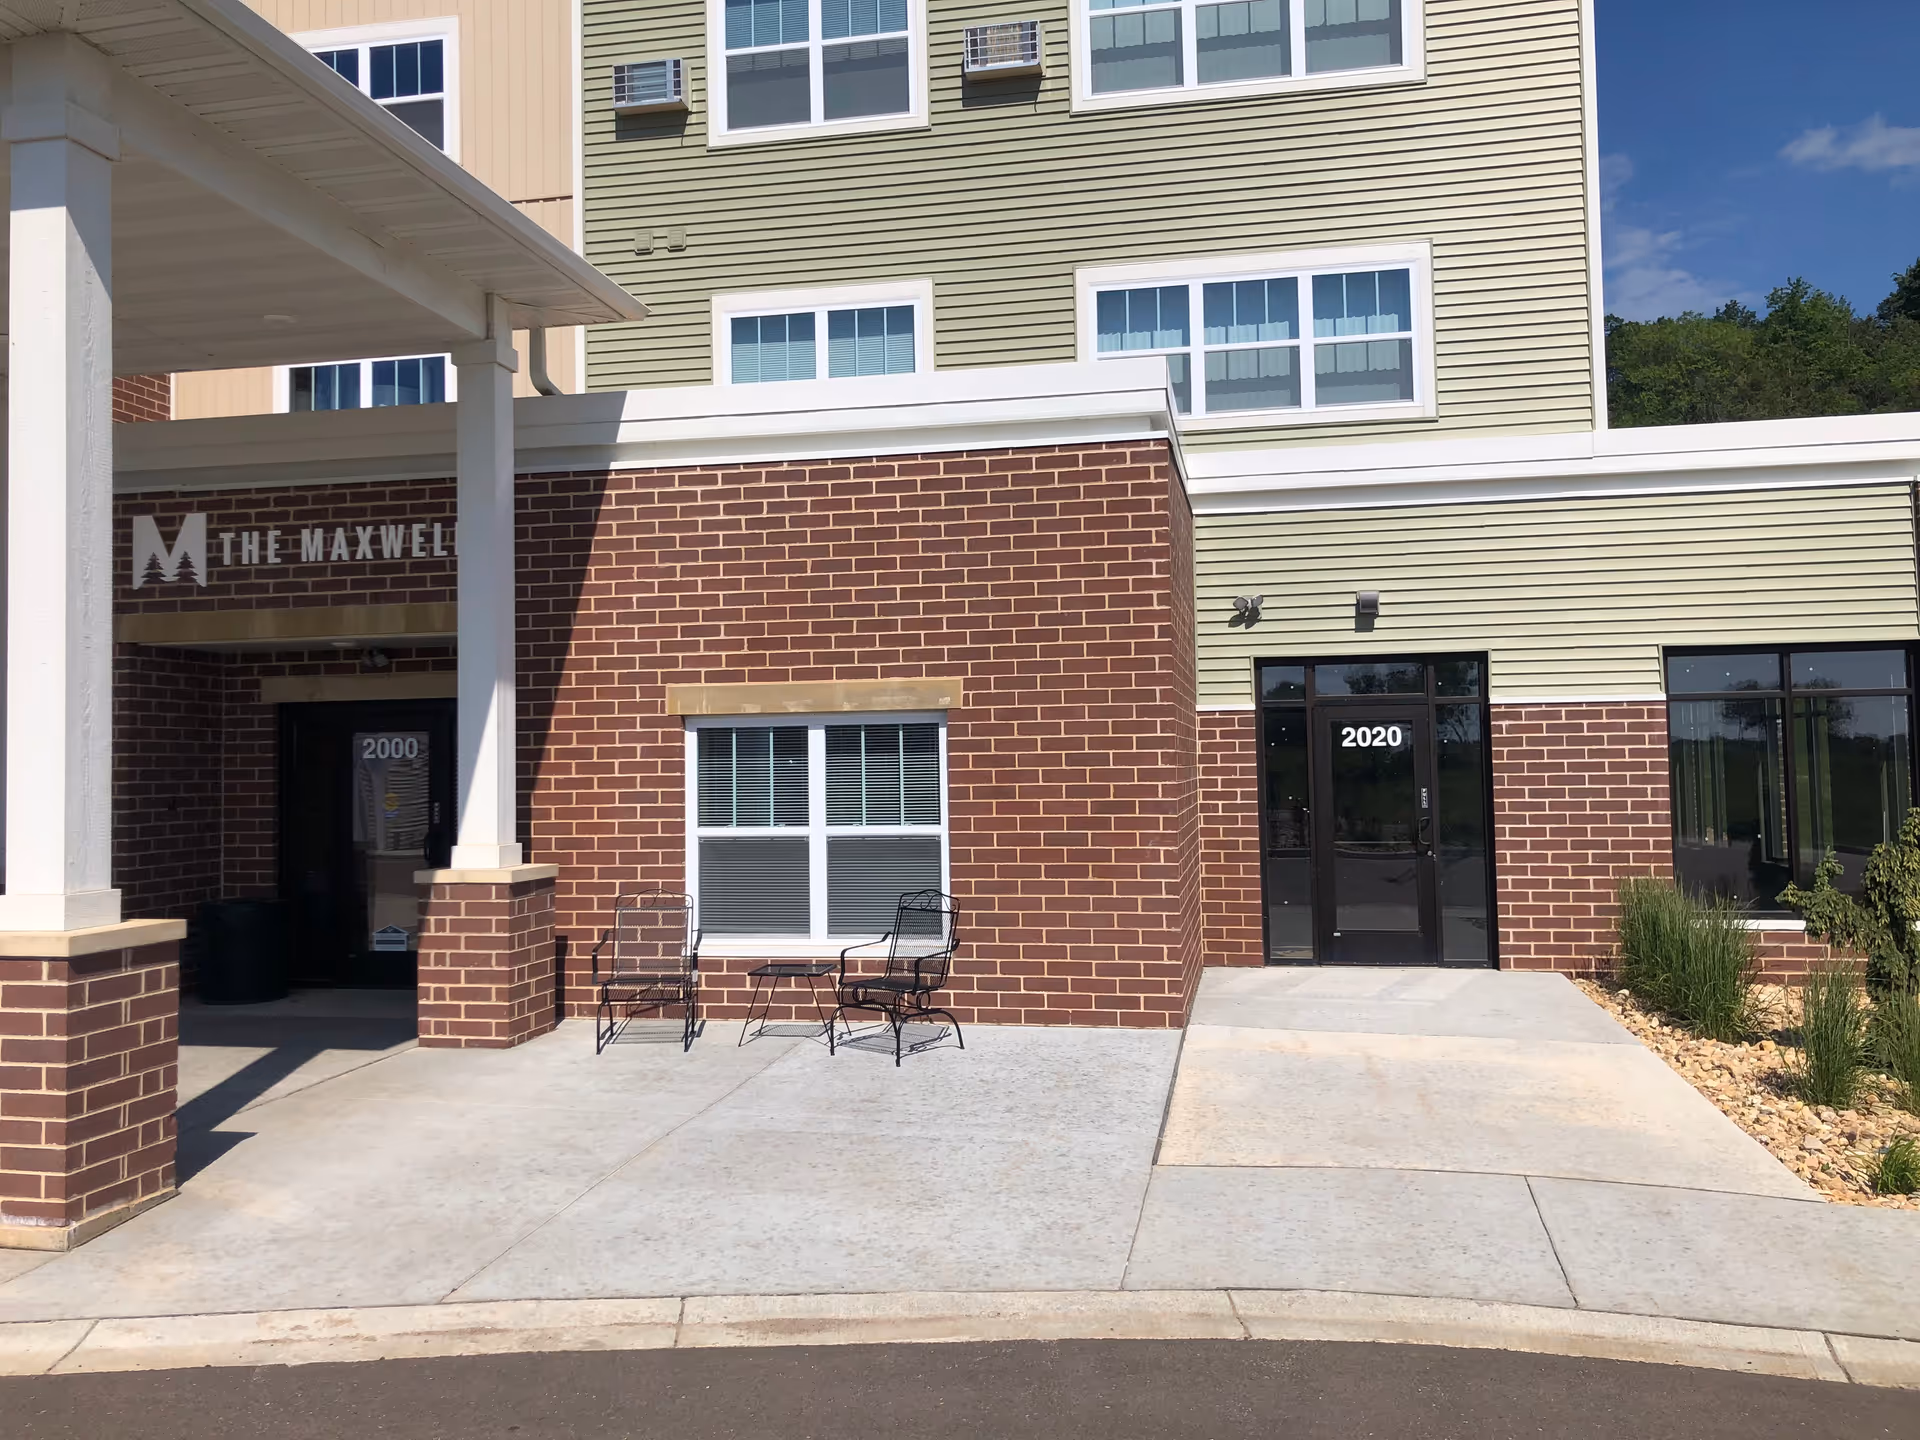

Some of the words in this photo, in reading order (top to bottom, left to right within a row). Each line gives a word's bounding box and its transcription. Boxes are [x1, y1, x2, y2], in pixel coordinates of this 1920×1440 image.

[132, 512, 207, 590] M
[219, 530, 282, 565] THE
[300, 522, 458, 562] MAXWEL
[362, 737, 419, 759] 2000
[1341, 726, 1402, 747] 2020
